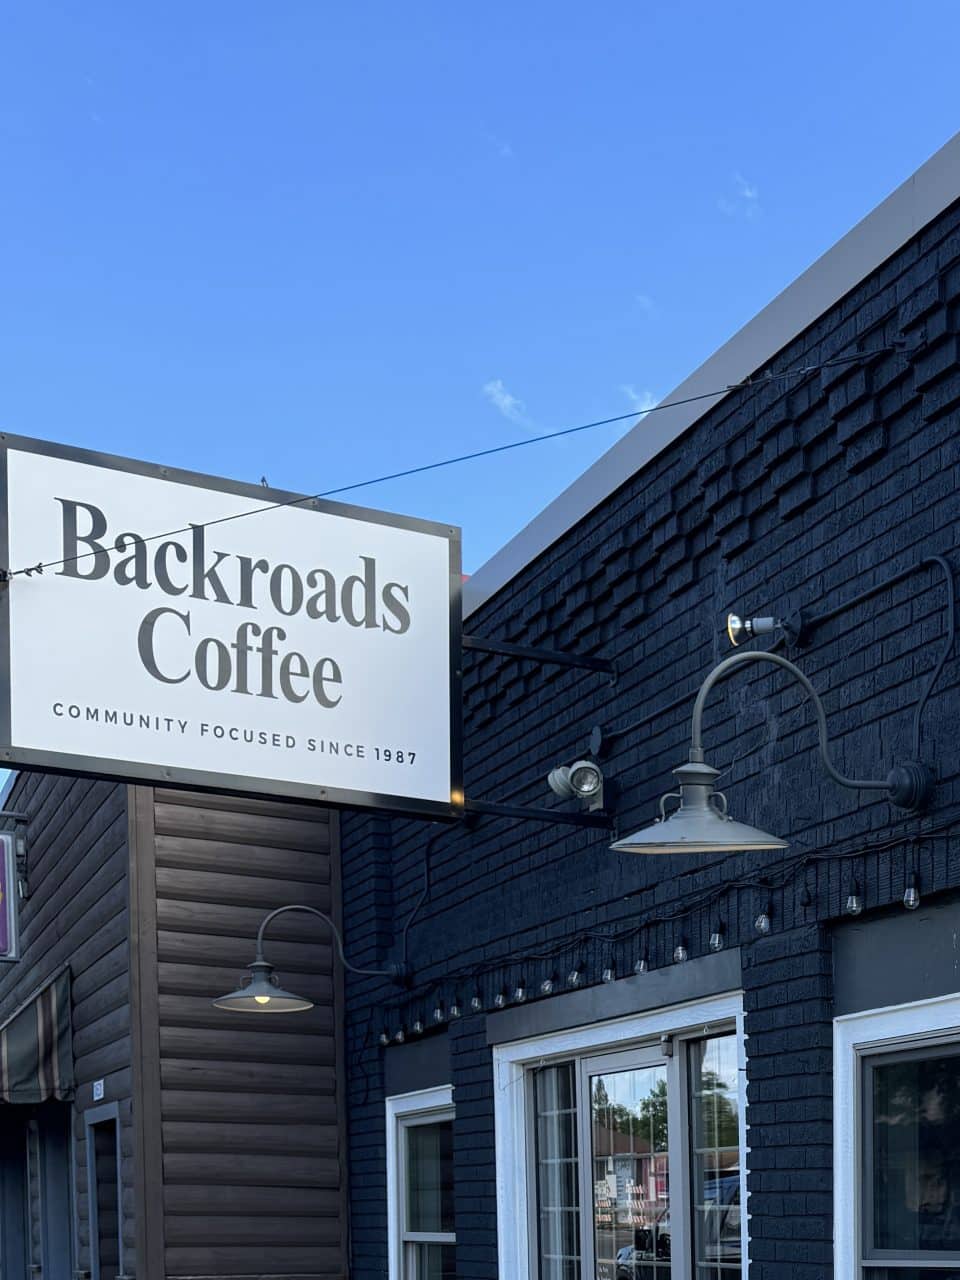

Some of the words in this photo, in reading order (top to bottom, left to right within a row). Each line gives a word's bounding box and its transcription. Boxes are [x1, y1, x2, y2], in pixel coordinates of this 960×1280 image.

[53, 496, 412, 635] Backroads
[137, 606, 343, 709] Coffee
[52, 702, 189, 734] COMMUNITY
[200, 723, 296, 749] FOCUSED
[307, 738, 366, 759] SINCE
[374, 747, 417, 767] 1987
